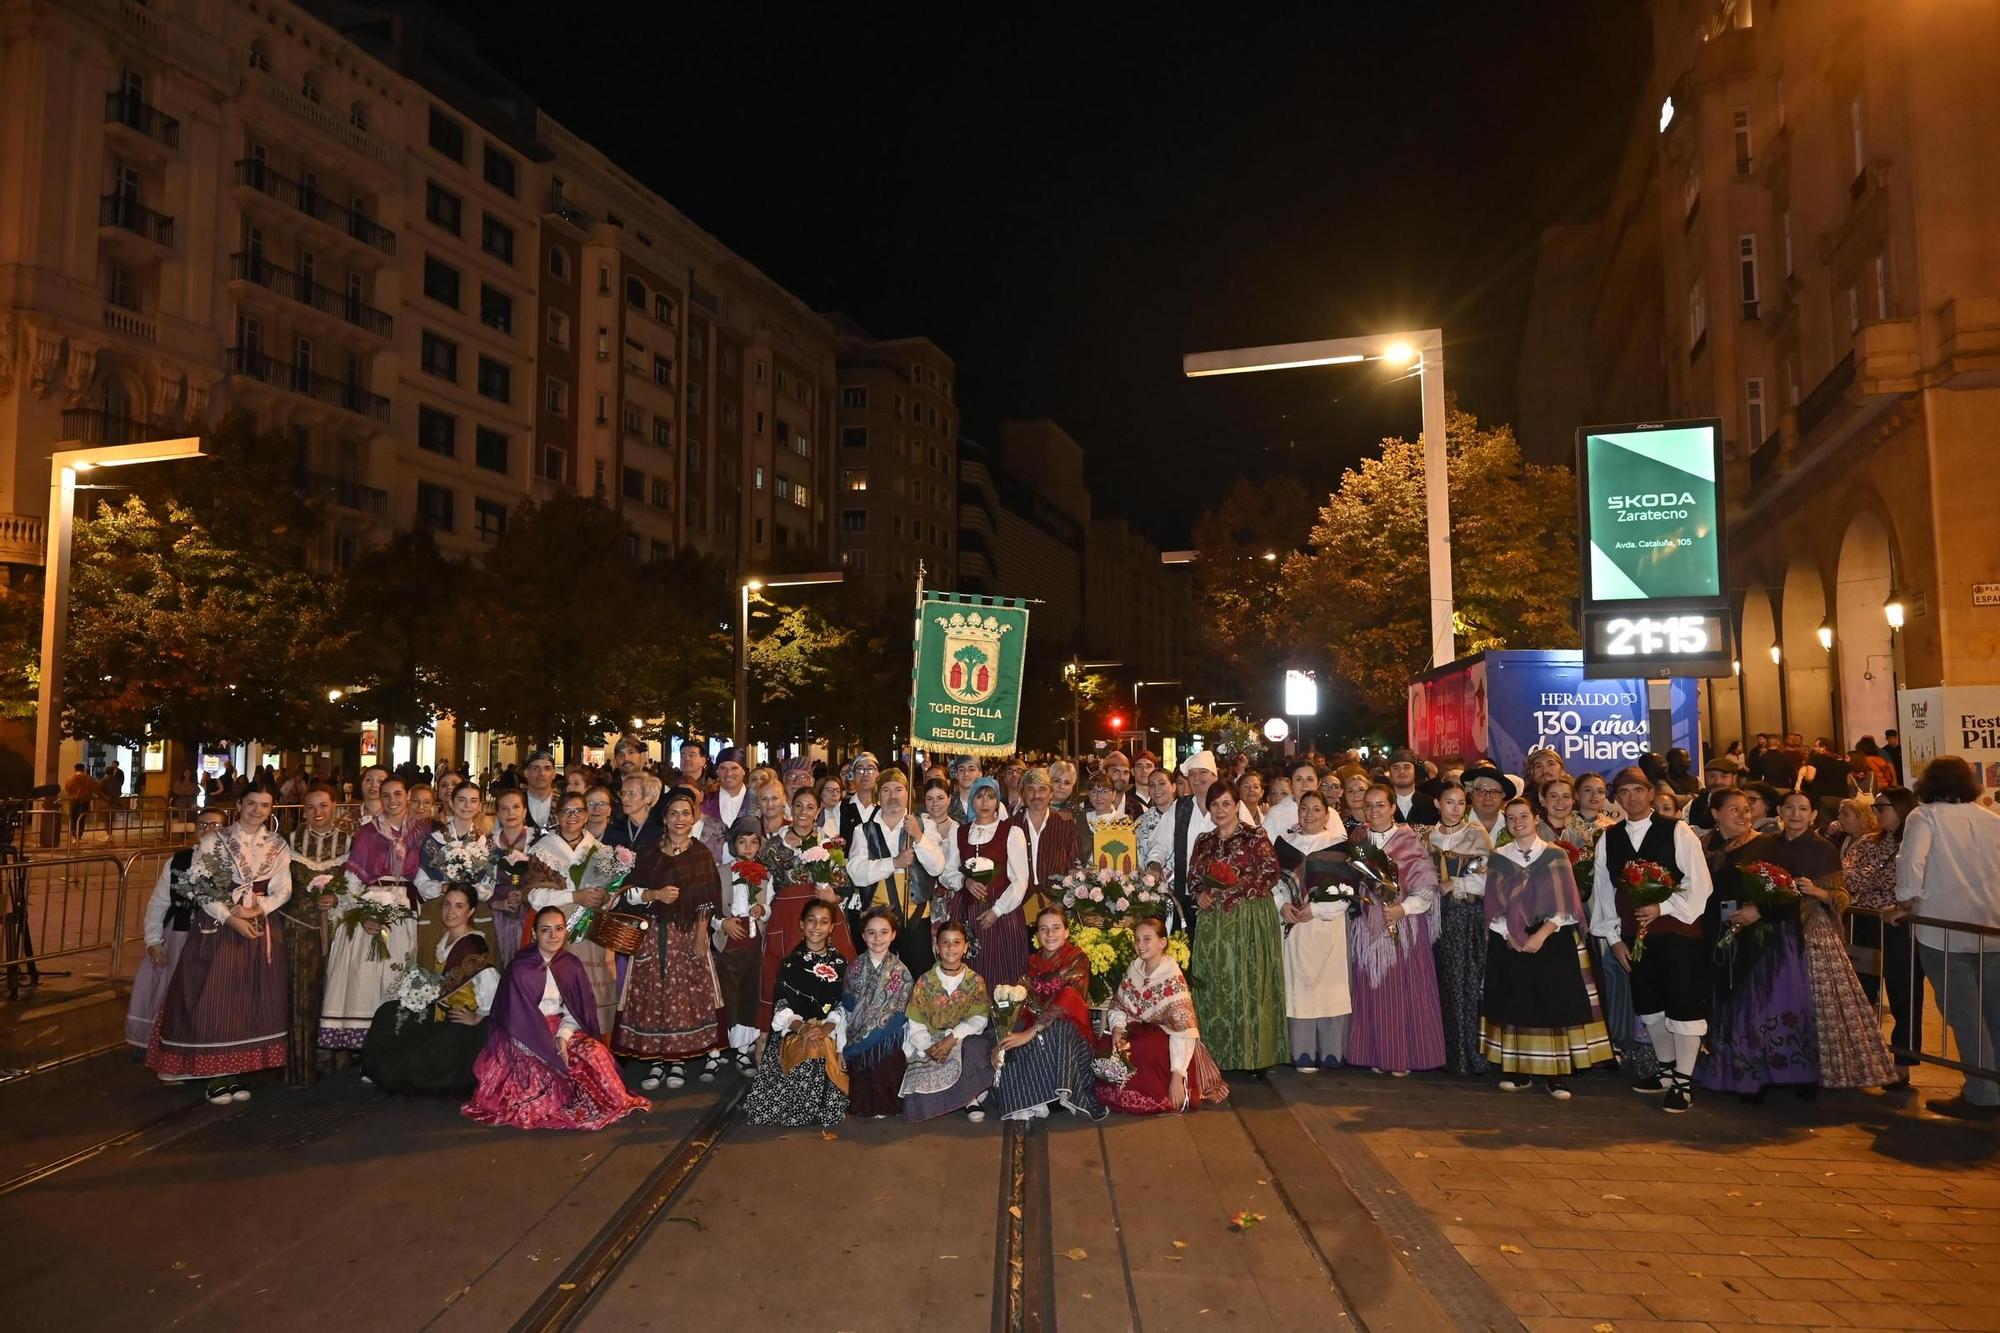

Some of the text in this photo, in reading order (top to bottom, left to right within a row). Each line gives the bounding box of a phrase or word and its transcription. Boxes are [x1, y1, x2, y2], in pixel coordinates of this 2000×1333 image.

[1608, 492, 1696, 509] SKODA
[1617, 509, 1688, 522] Zaratecno
[1615, 538, 1692, 549] Avda. Cataluña, 105
[1606, 616, 1707, 655] 21:15
[1541, 693, 1618, 706] HERALDO
[929, 703, 1002, 718] TORRECILLA
[952, 717, 975, 728] DEL
[1533, 711, 1647, 735] 130 años
[932, 728, 995, 742] REBOLLAR
[1564, 735, 1649, 760] Pilares
